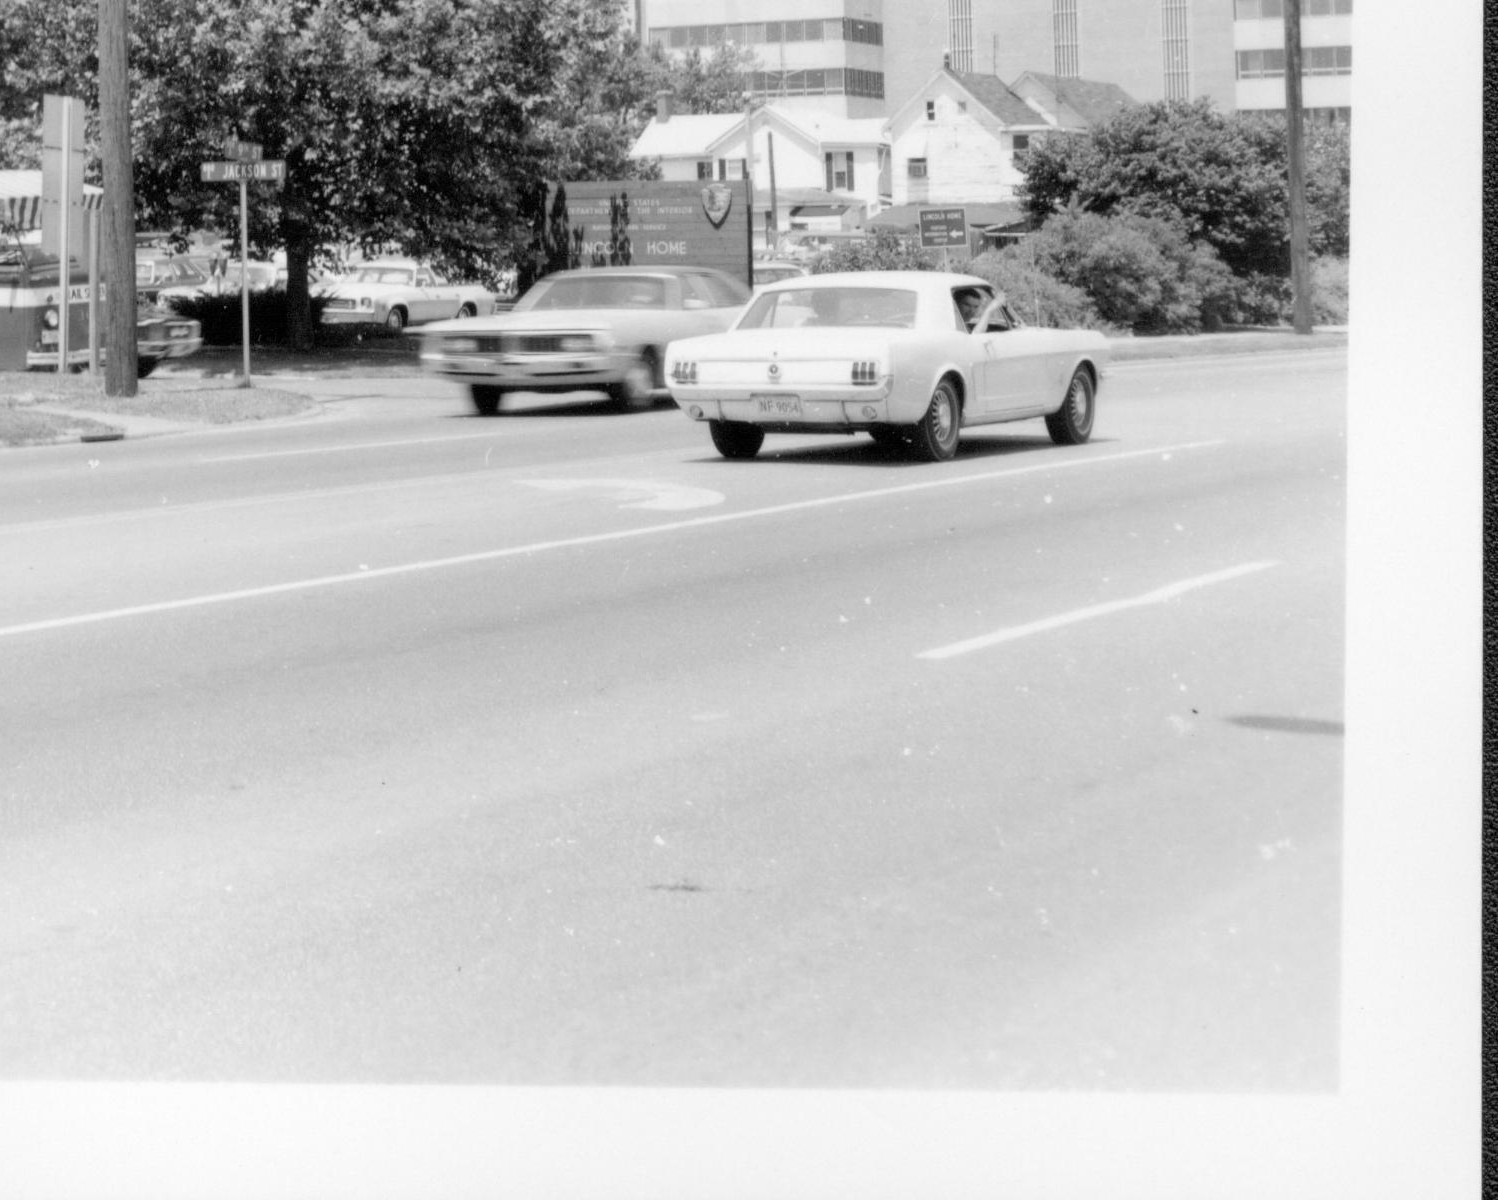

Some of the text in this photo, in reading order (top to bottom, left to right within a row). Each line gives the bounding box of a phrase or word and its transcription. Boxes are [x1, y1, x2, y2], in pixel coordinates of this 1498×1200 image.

[222, 163, 267, 179] JACKSON
[271, 162, 283, 177] ST
[633, 198, 660, 206] STATES
[567, 207, 613, 215] DEPARTMEN
[637, 207, 651, 215] THE
[657, 206, 693, 215] INTERIOR
[922, 213, 945, 221] LINCOLN
[647, 240, 687, 255] HOME
